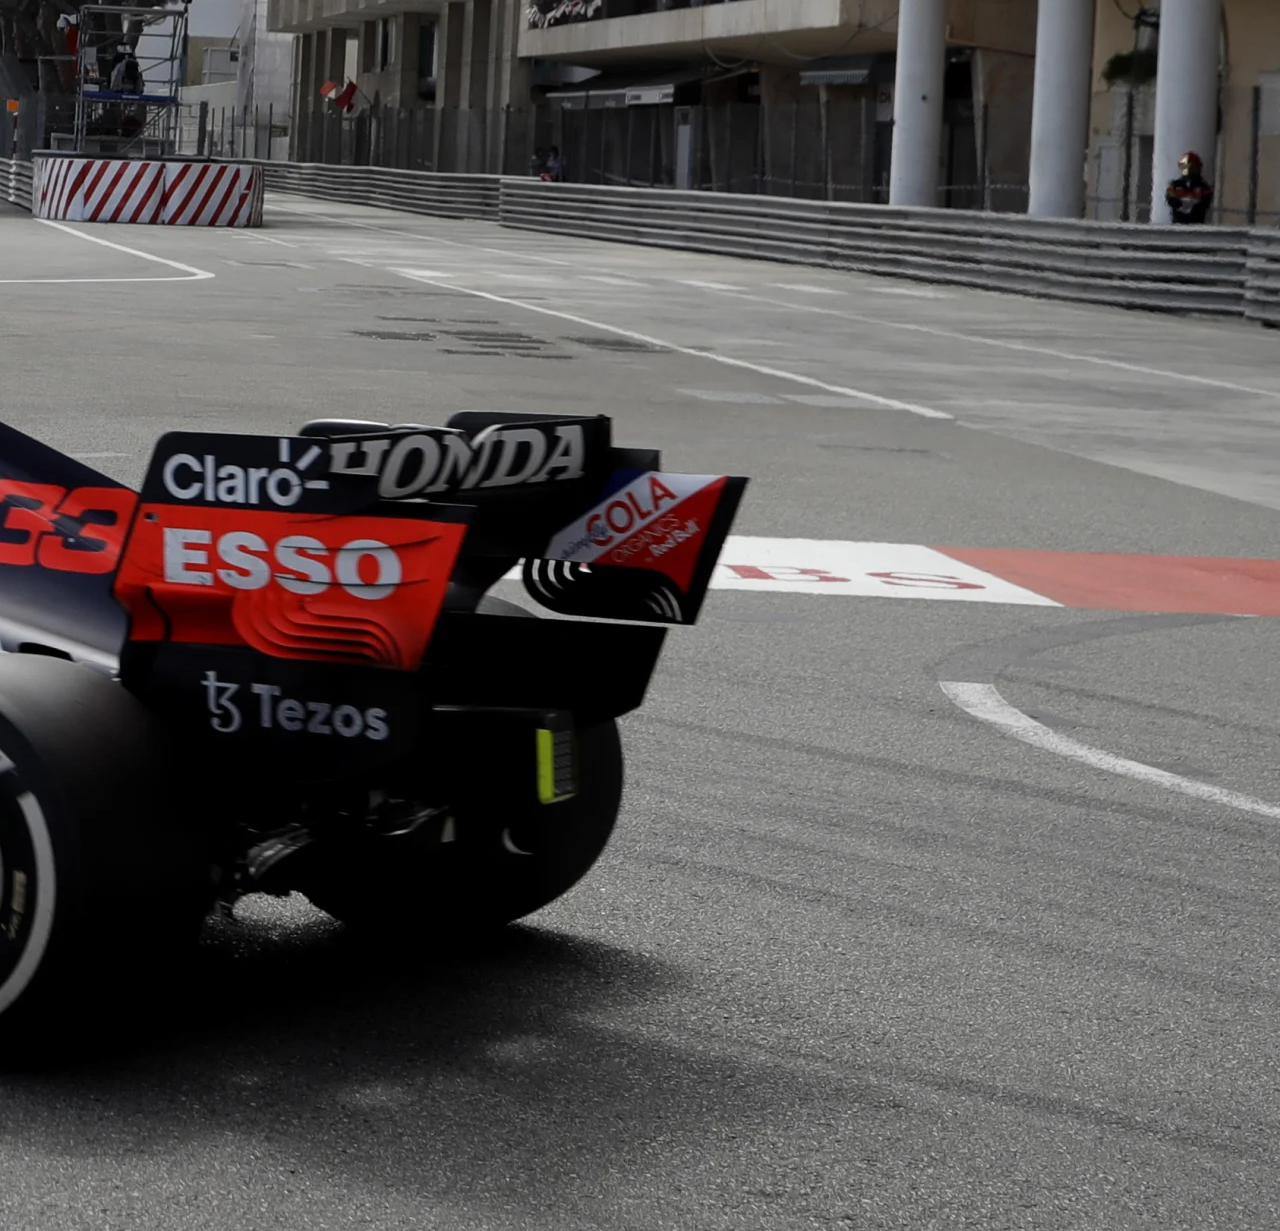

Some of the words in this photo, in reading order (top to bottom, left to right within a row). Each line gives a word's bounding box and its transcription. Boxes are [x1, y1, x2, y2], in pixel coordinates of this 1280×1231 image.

[161, 452, 303, 507] Claro
[328, 424, 586, 499] HONDA
[586, 476, 678, 547] COLA
[161, 526, 403, 601] ESSO
[250, 683, 391, 742] Tezos
